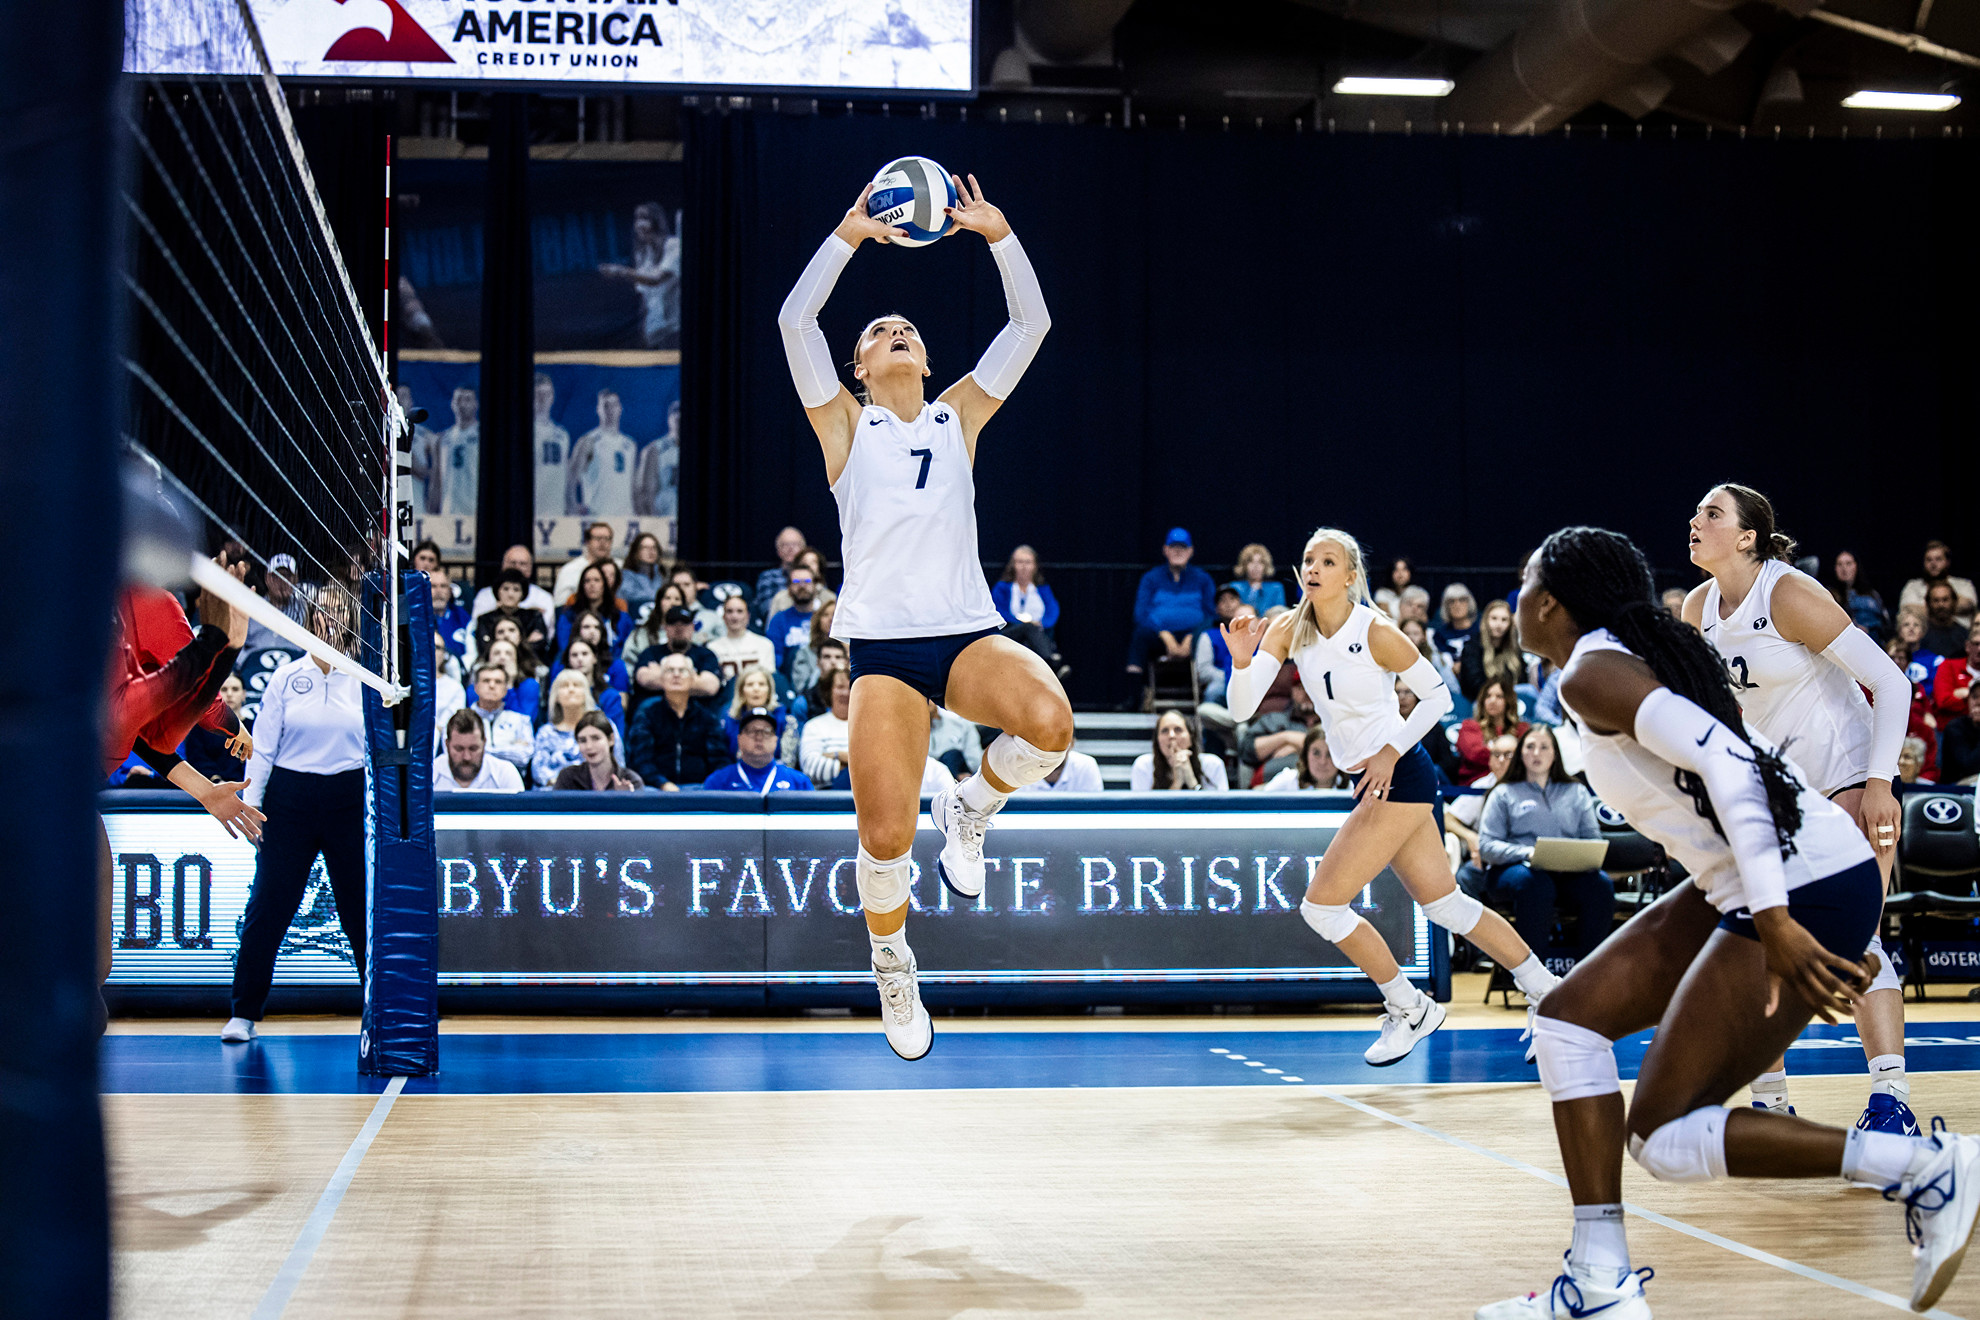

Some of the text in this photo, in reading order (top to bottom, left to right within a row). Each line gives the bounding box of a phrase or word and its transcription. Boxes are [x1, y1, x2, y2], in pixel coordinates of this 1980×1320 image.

[452, 9, 663, 47] AMERICA
[477, 52, 639, 68] CREDIT UNION
[909, 448, 933, 490] 7
[1323, 671, 1334, 700] 1
[438, 857, 655, 915] BYU'S
